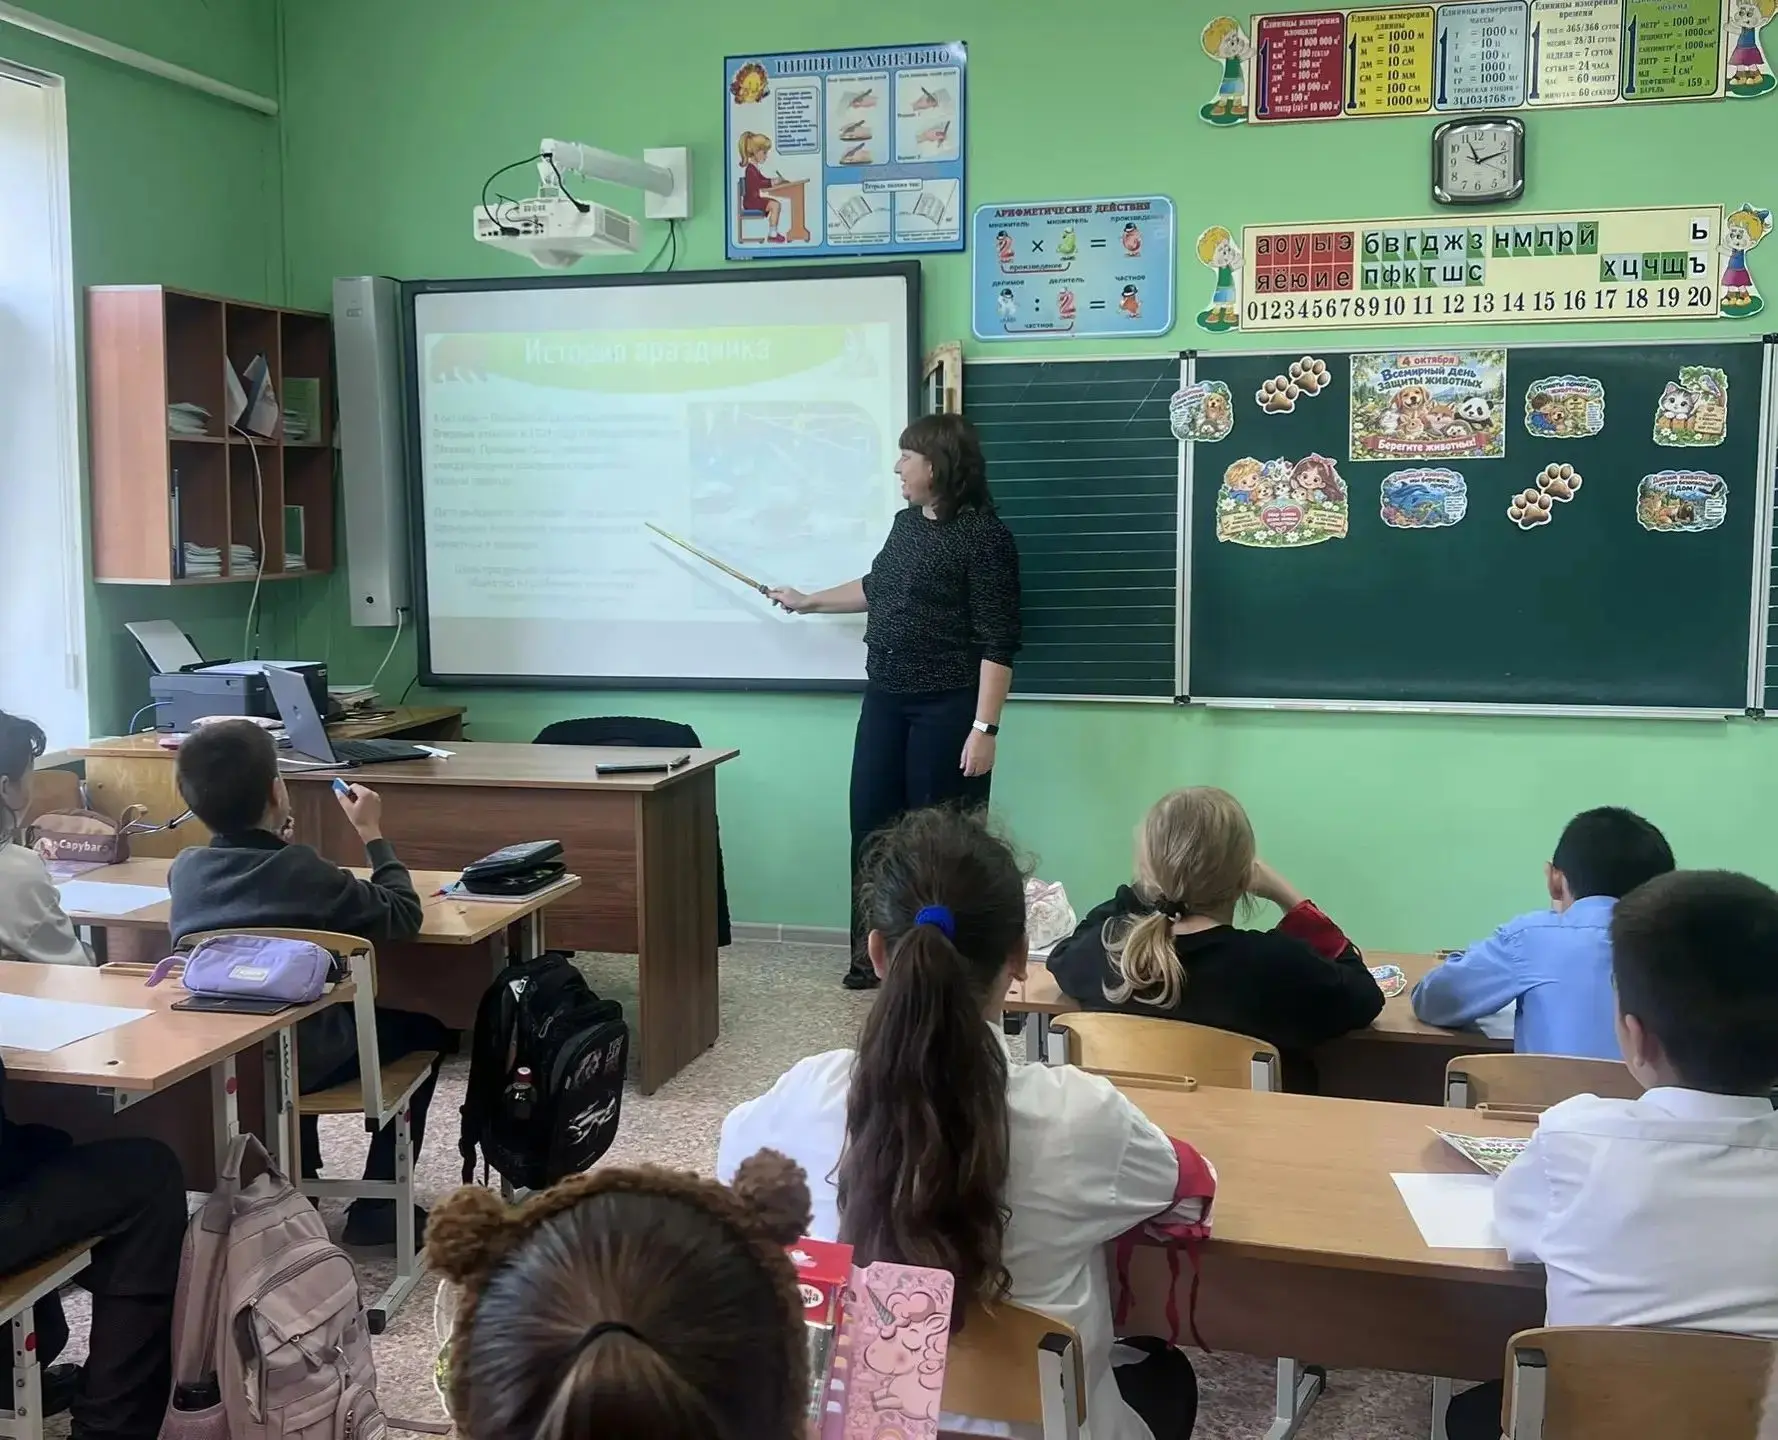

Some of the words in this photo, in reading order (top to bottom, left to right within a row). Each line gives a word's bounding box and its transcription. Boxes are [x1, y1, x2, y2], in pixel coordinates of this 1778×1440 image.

[1673, 16, 1694, 27] 1000
[1482, 26, 1507, 37] 1000
[1566, 23, 1599, 33] 365/366
[1390, 30, 1415, 41] 1000
[1388, 43, 1400, 54] 10
[1482, 38, 1493, 48] 10
[1482, 50, 1499, 60] 100
[1584, 47, 1590, 57] 7
[839, 50, 950, 70] ПРАВИЛЬНО
[1388, 56, 1400, 67] 10
[1481, 61, 1505, 72] 1000
[1388, 70, 1399, 80] 10
[1481, 72, 1506, 83] 1000
[1577, 73, 1589, 83] 60
[1688, 77, 1703, 87] 159
[1387, 83, 1406, 94] 100
[1578, 88, 1590, 97] 60
[1387, 95, 1413, 107] 1000
[1461, 134, 1469, 144] 11
[1474, 131, 1484, 141] 12
[1493, 132, 1497, 142] 1
[1451, 144, 1459, 154] 10
[1500, 141, 1507, 151] 2
[1450, 159, 1457, 168] 9
[1500, 155, 1507, 165] 3
[1451, 172, 1458, 181] 8
[1461, 180, 1467, 190] 7
[1474, 180, 1481, 191] 6
[1491, 178, 1498, 189] 5
[994, 205, 1093, 218] АРИФМЕТИЧЕСКИЕ
[1095, 202, 1151, 213] ДЕЙСТВИЯ
[1384, 296, 1405, 316] 10
[1413, 295, 1433, 315] 11
[1443, 294, 1465, 314] 12
[1473, 293, 1494, 313] 13
[1503, 292, 1525, 312] 14
[1533, 291, 1556, 311] 15
[1563, 290, 1586, 310] 16
[1594, 289, 1617, 309] 17
[1625, 288, 1648, 309] 18
[1656, 287, 1680, 307] 19
[1688, 286, 1712, 307] 20
[1402, 356, 1411, 365] 4
[1414, 354, 1455, 365] октября
[1381, 366, 1446, 382] Всемирный
[1424, 375, 1483, 389] животных
[1378, 439, 1424, 452] Берегите
[1425, 438, 1477, 452] животных!
